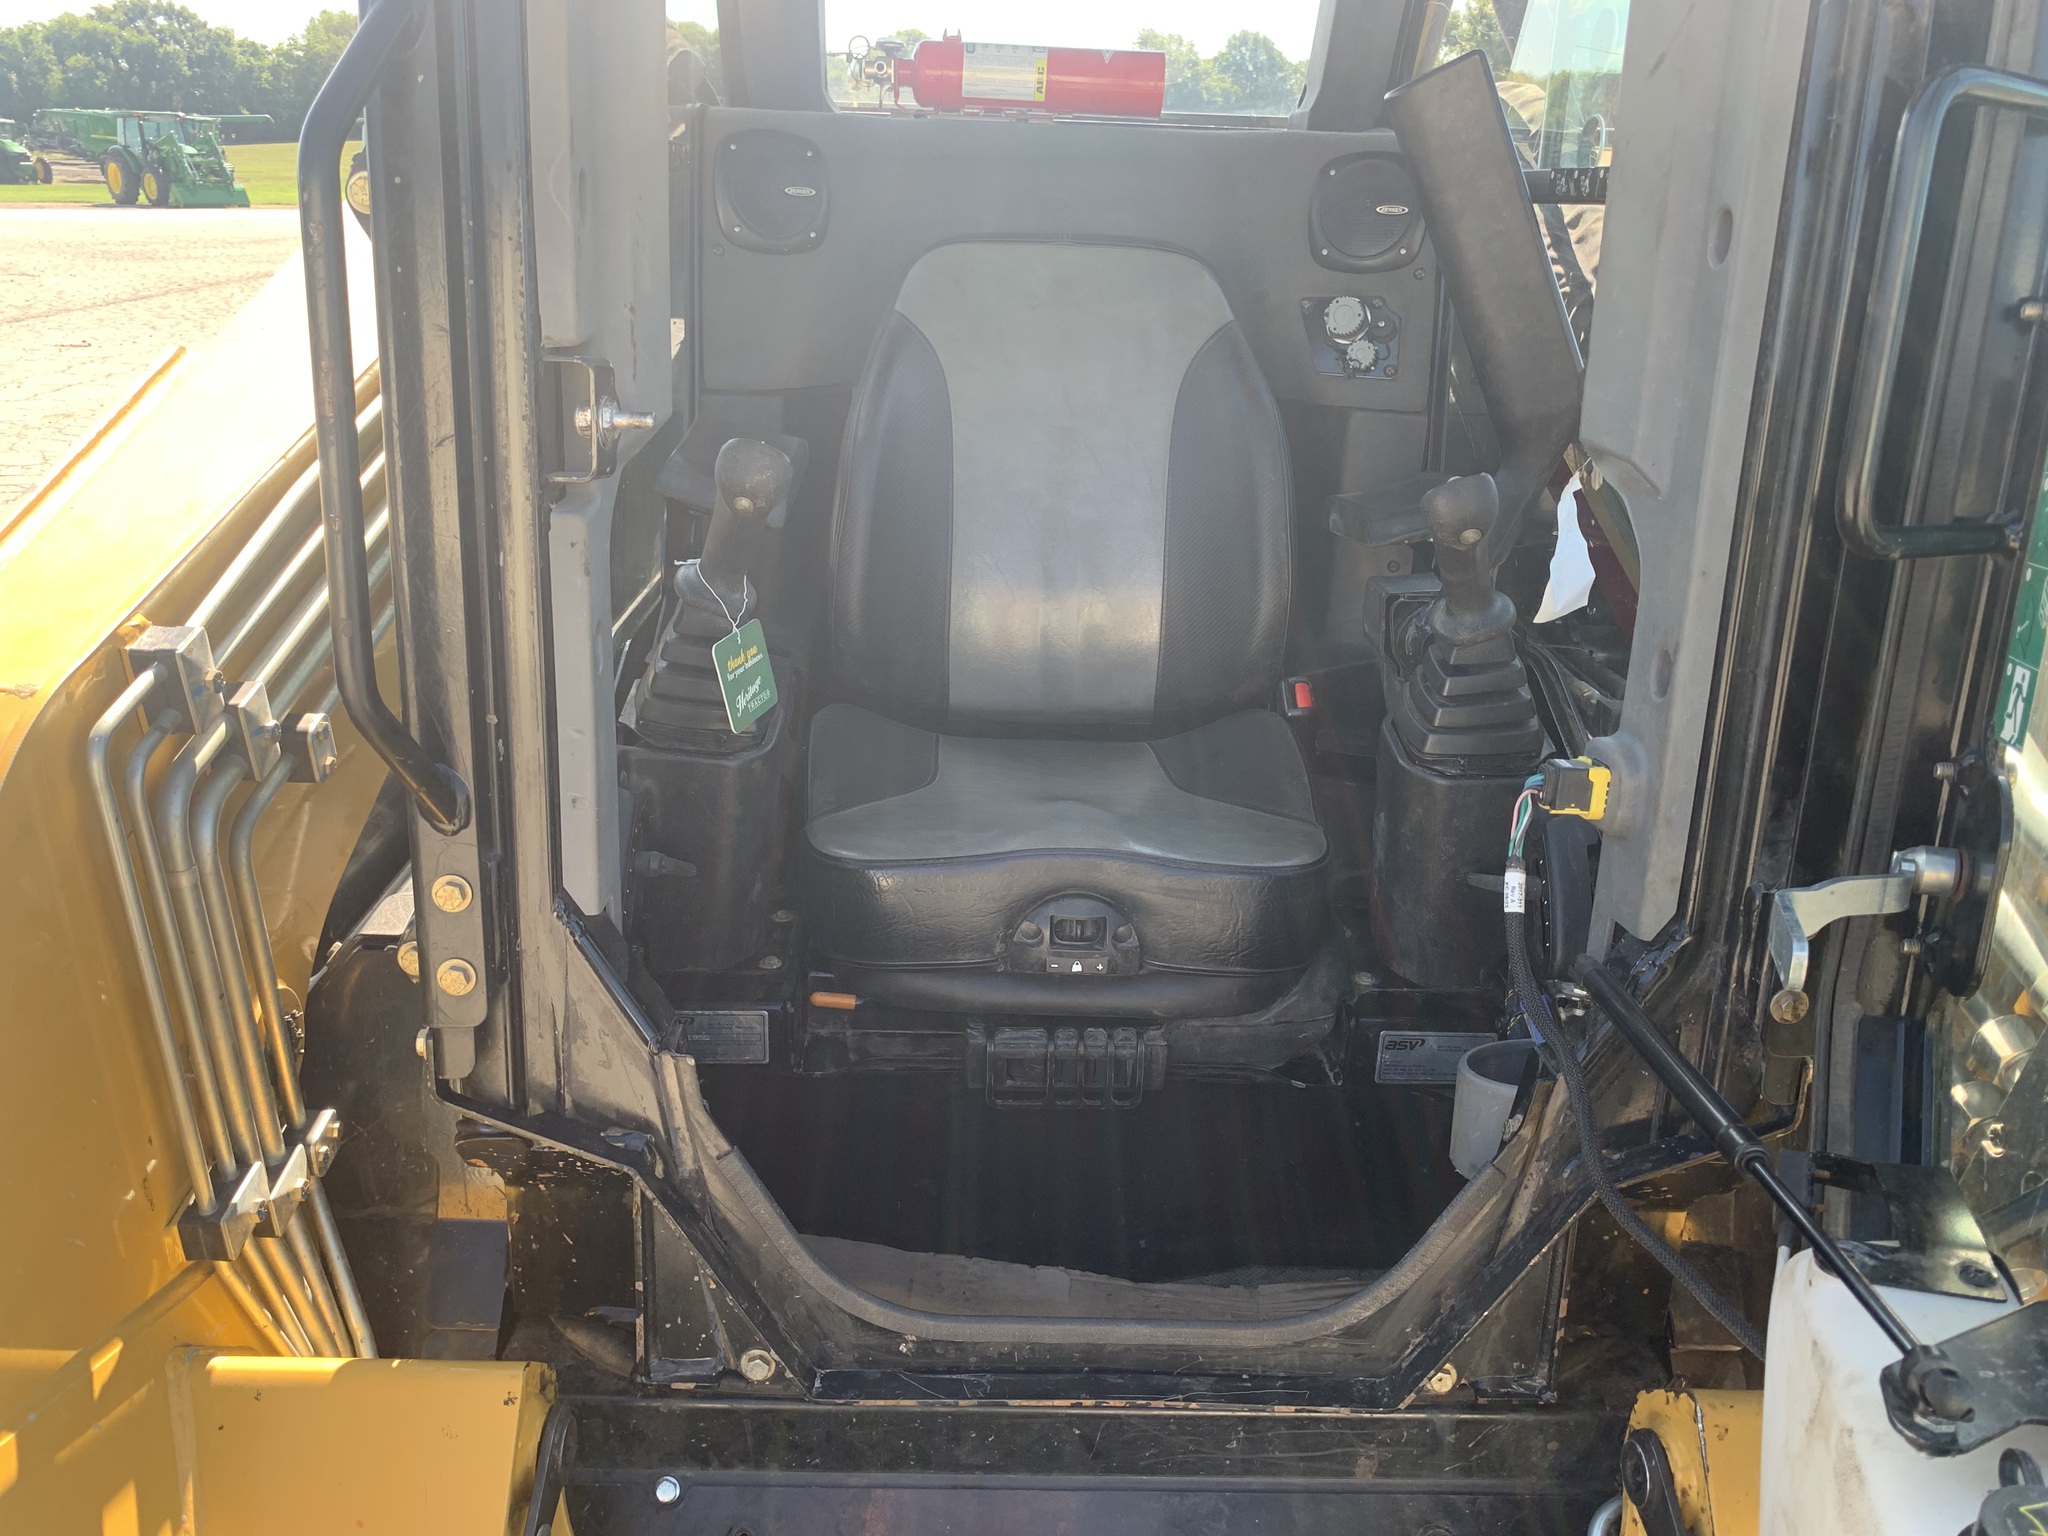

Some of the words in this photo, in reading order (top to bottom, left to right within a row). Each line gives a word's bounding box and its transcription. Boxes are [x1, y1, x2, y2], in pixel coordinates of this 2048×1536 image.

[728, 648, 745, 672] thank
[746, 645, 758, 660] you
[735, 665, 745, 679] your
[744, 653, 763, 669] business
[736, 676, 761, 717] Heritage
[747, 689, 771, 711] TRACTOR
